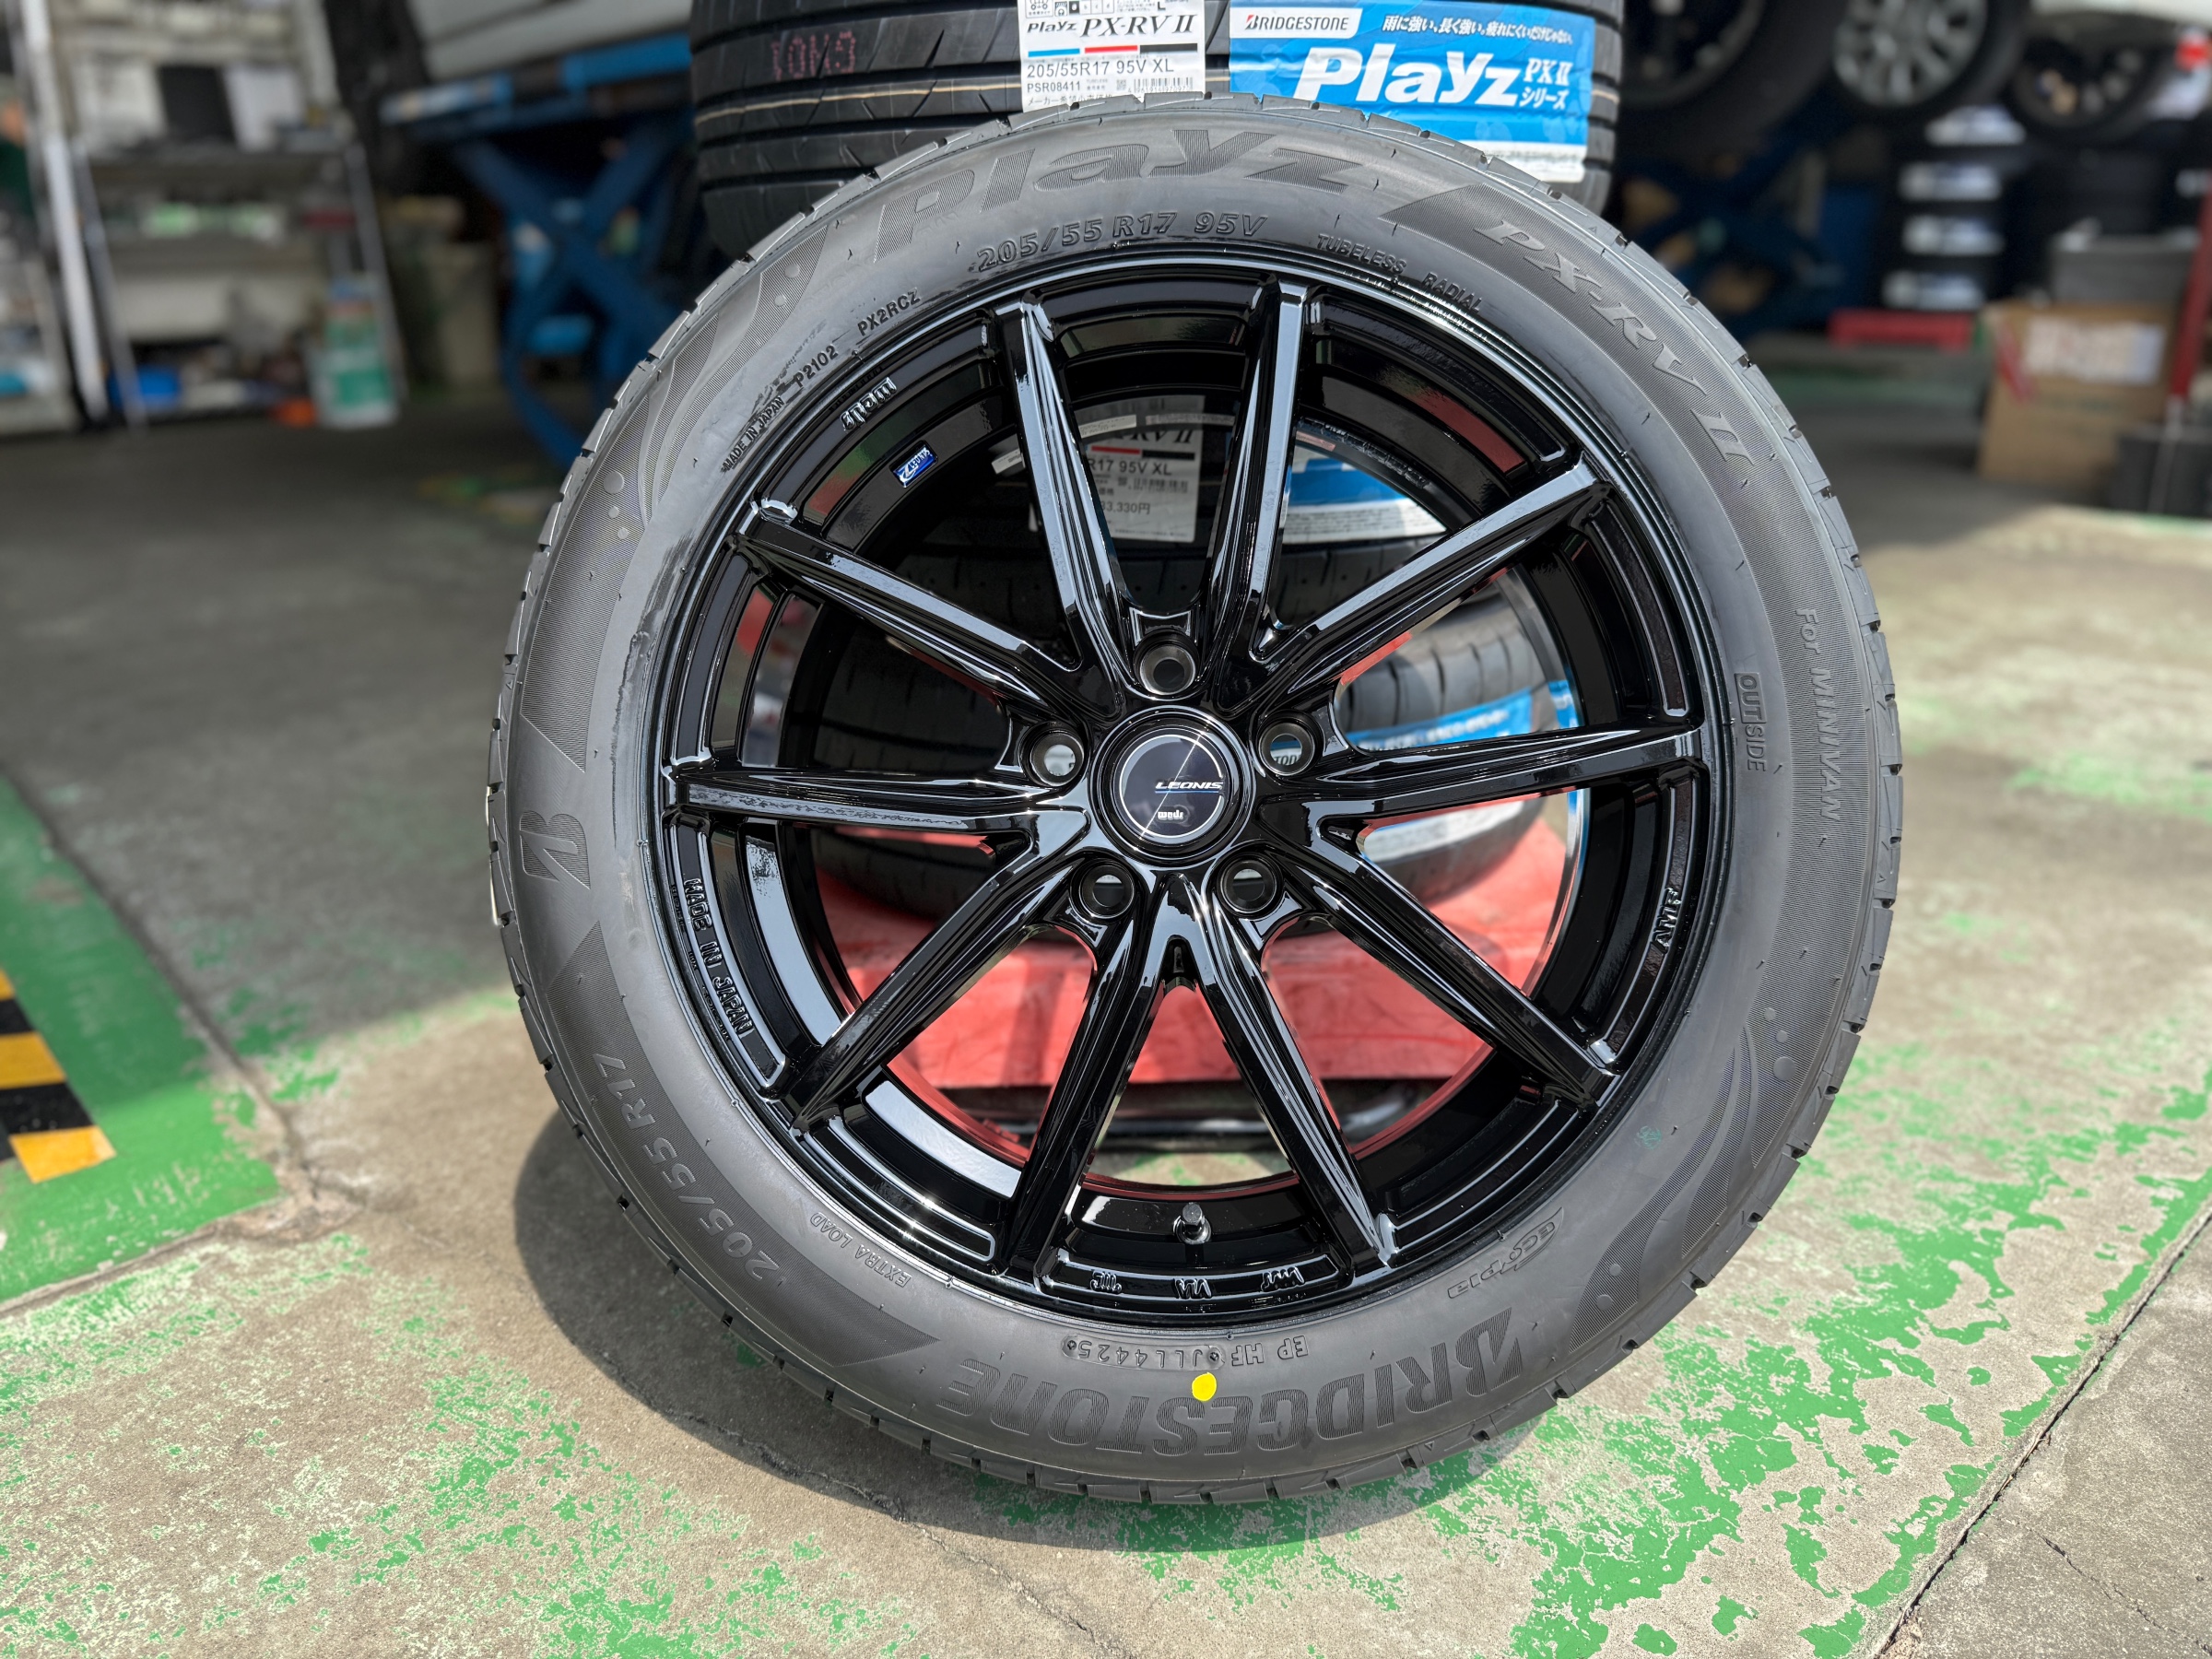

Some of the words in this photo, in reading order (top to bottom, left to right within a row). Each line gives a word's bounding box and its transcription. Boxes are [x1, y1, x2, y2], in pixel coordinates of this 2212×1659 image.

[1027, 20, 1077, 33] Playz
[1079, 15, 1171, 38] PX-RV
[1244, 14, 1349, 30] BRIDGESTONE
[1027, 61, 1109, 78] 205/55R17
[1116, 59, 1147, 74] 95V
[1152, 58, 1174, 73] XL
[1027, 80, 1080, 93] PSR08411
[1293, 43, 1524, 107] Playz
[1519, 87, 1570, 110] シリーズ
[874, 129, 1369, 264] Playz
[977, 217, 1103, 273] 205/55
[1112, 212, 1178, 238] R17
[1194, 212, 1268, 237] 95V
[1318, 233, 1407, 275] TUBELESS
[1422, 272, 1484, 313] RADIAL
[1473, 219, 1708, 396] PX-RV
[723, 437, 748, 472] MADE
[747, 426, 759, 445] IN
[759, 395, 785, 430] JAPAN
[793, 344, 840, 389] P2102
[857, 287, 921, 337] PX2RCZ
[1120, 461, 1147, 474] 95V
[1152, 463, 1172, 476] XL
[1735, 672, 1767, 772] OUTSIDE
[1810, 667, 1843, 822] MINIVAN
[1155, 782, 1223, 790] LEONIS
[700, 940, 723, 969] IN
[712, 975, 755, 1038] JAPAN
[594, 1053, 656, 1130] R17
[644, 1135, 782, 1283] 205/55
[810, 1212, 853, 1249] LOAD
[854, 1244, 914, 1288] EXTRA
[936, 1307, 1522, 1456] BRIDGESTONE
